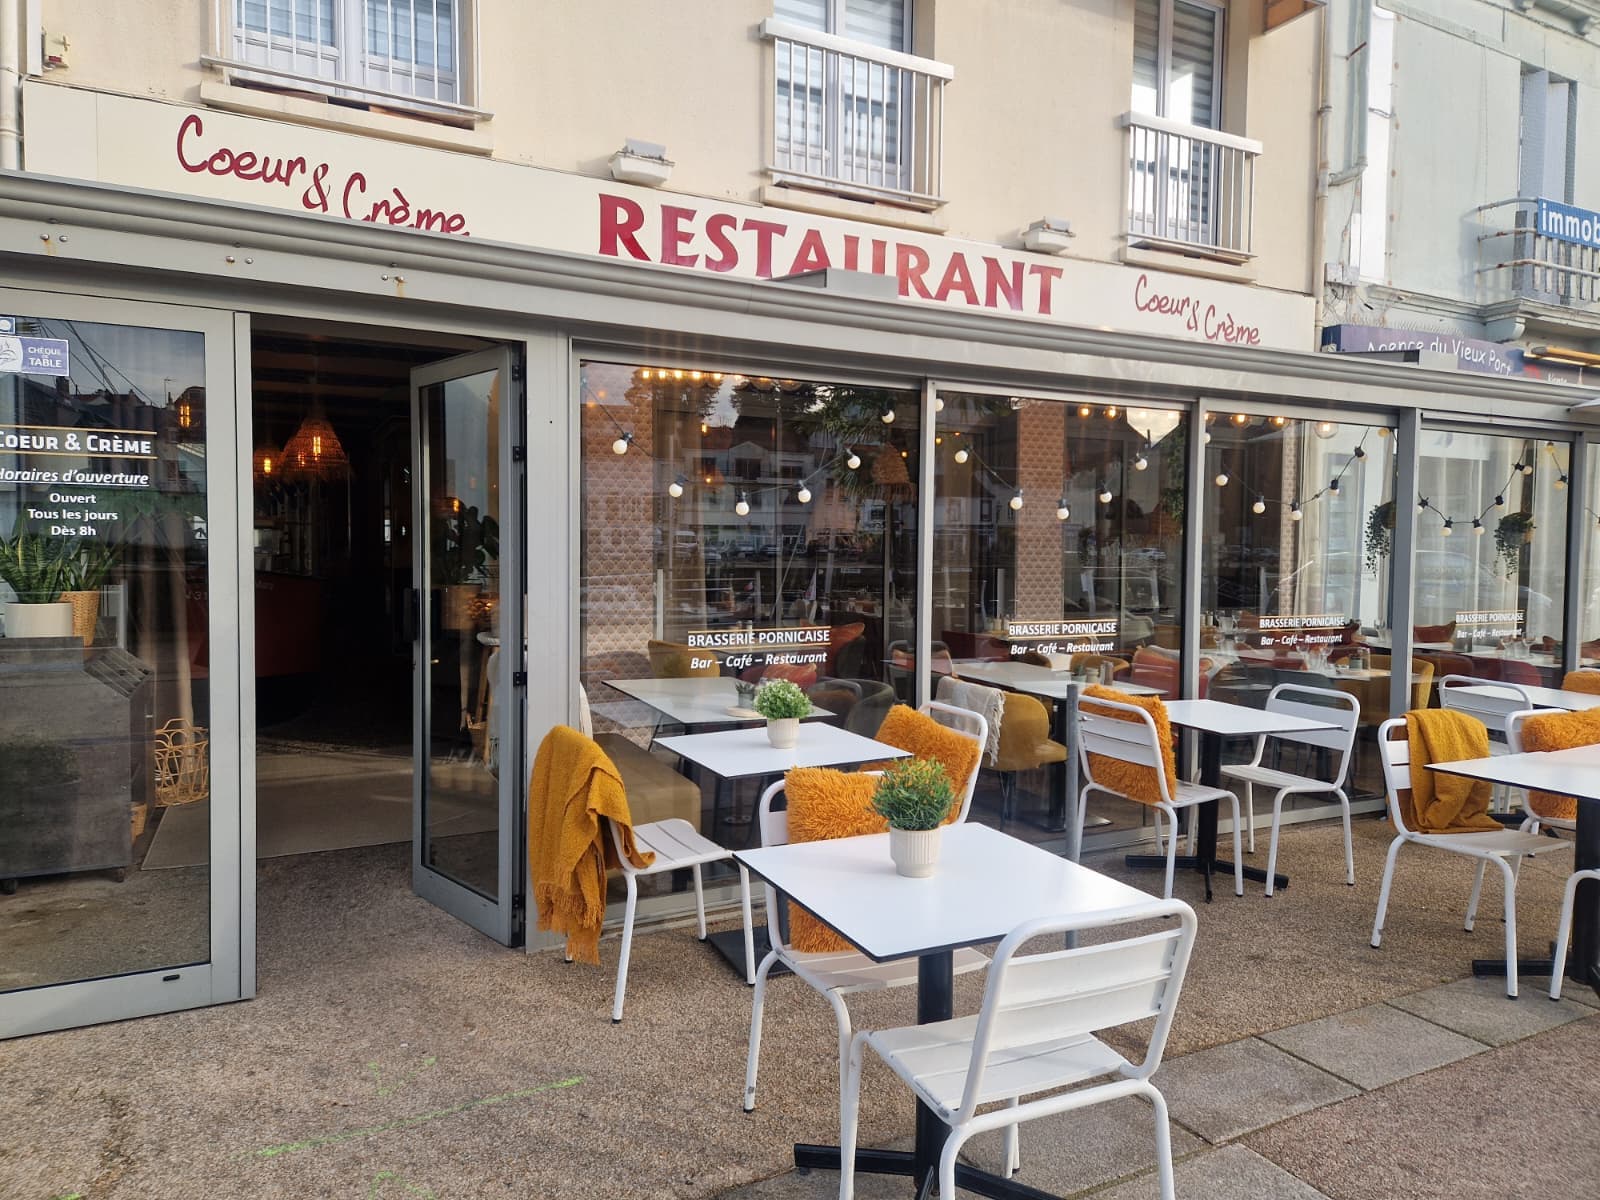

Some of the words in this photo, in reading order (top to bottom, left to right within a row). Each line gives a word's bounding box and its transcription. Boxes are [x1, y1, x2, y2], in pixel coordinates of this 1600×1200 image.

[177, 114, 306, 186] Coeur
[302, 163, 331, 212] &
[343, 172, 470, 237] Crème
[598, 193, 1064, 316] RESTAURANT
[1135, 274, 1190, 316] Coeur
[1186, 300, 1200, 331] &
[1204, 304, 1261, 344] Crème
[28, 357, 63, 368] TABLE
[1430, 336, 1447, 354] du
[1452, 338, 1486, 364] Vieux
[1488, 349, 1512, 375] Port
[65, 433, 81, 451] &
[86, 435, 152, 454] CRÈME
[62, 469, 149, 485] d'ouverture
[50, 493, 97, 504] Ouvert
[28, 508, 59, 520] Tous
[62, 509, 82, 520] les
[84, 510, 119, 522] jours
[51, 525, 76, 536] Dès
[79, 525, 97, 536] 8h
[1009, 624, 1060, 635] BRASSERIE
[1062, 622, 1117, 634] PORNICAISE
[1260, 618, 1300, 628] BRASSERIE
[1301, 616, 1345, 627] PORNICAISE
[688, 633, 755, 647] BRASSERIE
[759, 630, 830, 644] PORNICAISE
[1261, 636, 1274, 645] Bar
[1281, 634, 1298, 646] Café
[1304, 634, 1342, 643] Restaurant
[1010, 645, 1028, 655] Bar
[1037, 643, 1057, 655] Café
[1066, 641, 1114, 652] Restaurant
[691, 658, 713, 669] Bar
[726, 654, 753, 669] Café
[765, 651, 827, 665] Restaurant
